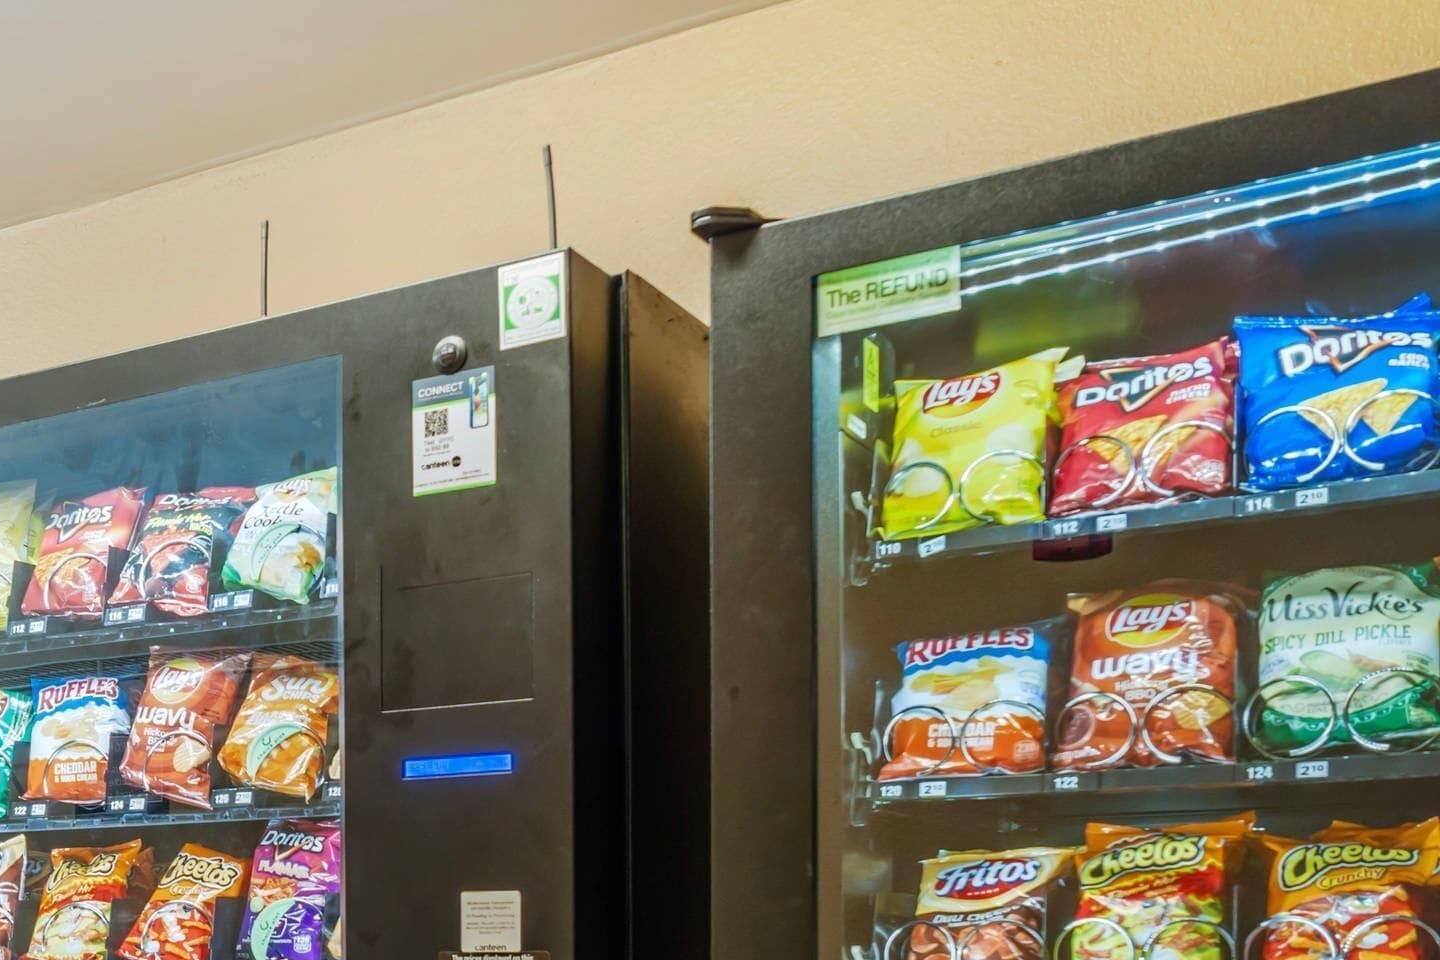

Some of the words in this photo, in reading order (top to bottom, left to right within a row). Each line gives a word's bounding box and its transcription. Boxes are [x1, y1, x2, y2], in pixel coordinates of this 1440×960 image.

[826, 289, 861, 309] The
[865, 268, 949, 300] REFUND
[1279, 330, 1433, 378] Doritos
[417, 380, 464, 399] CONNECT
[923, 373, 998, 411] Lay's
[1075, 355, 1214, 409] Doritos
[1245, 498, 1273, 512] 114
[1053, 521, 1078, 535] 112
[1112, 599, 1194, 636] Lay's
[904, 626, 1034, 668] RUFFLES
[1264, 633, 1307, 655] SPICY
[1314, 630, 1346, 647] DILL
[1354, 624, 1412, 641] PICKLE
[1091, 648, 1199, 682] wavy
[38, 677, 120, 712] RUFFLES
[137, 706, 196, 731] wavy
[1053, 776, 1079, 789] 122
[1246, 766, 1274, 779] 124
[260, 831, 325, 852] Doritos
[933, 856, 1041, 896] Fritos
[1081, 833, 1207, 890] Cheetos
[1316, 867, 1386, 890] Crunchy
[474, 944, 507, 952] canteen
